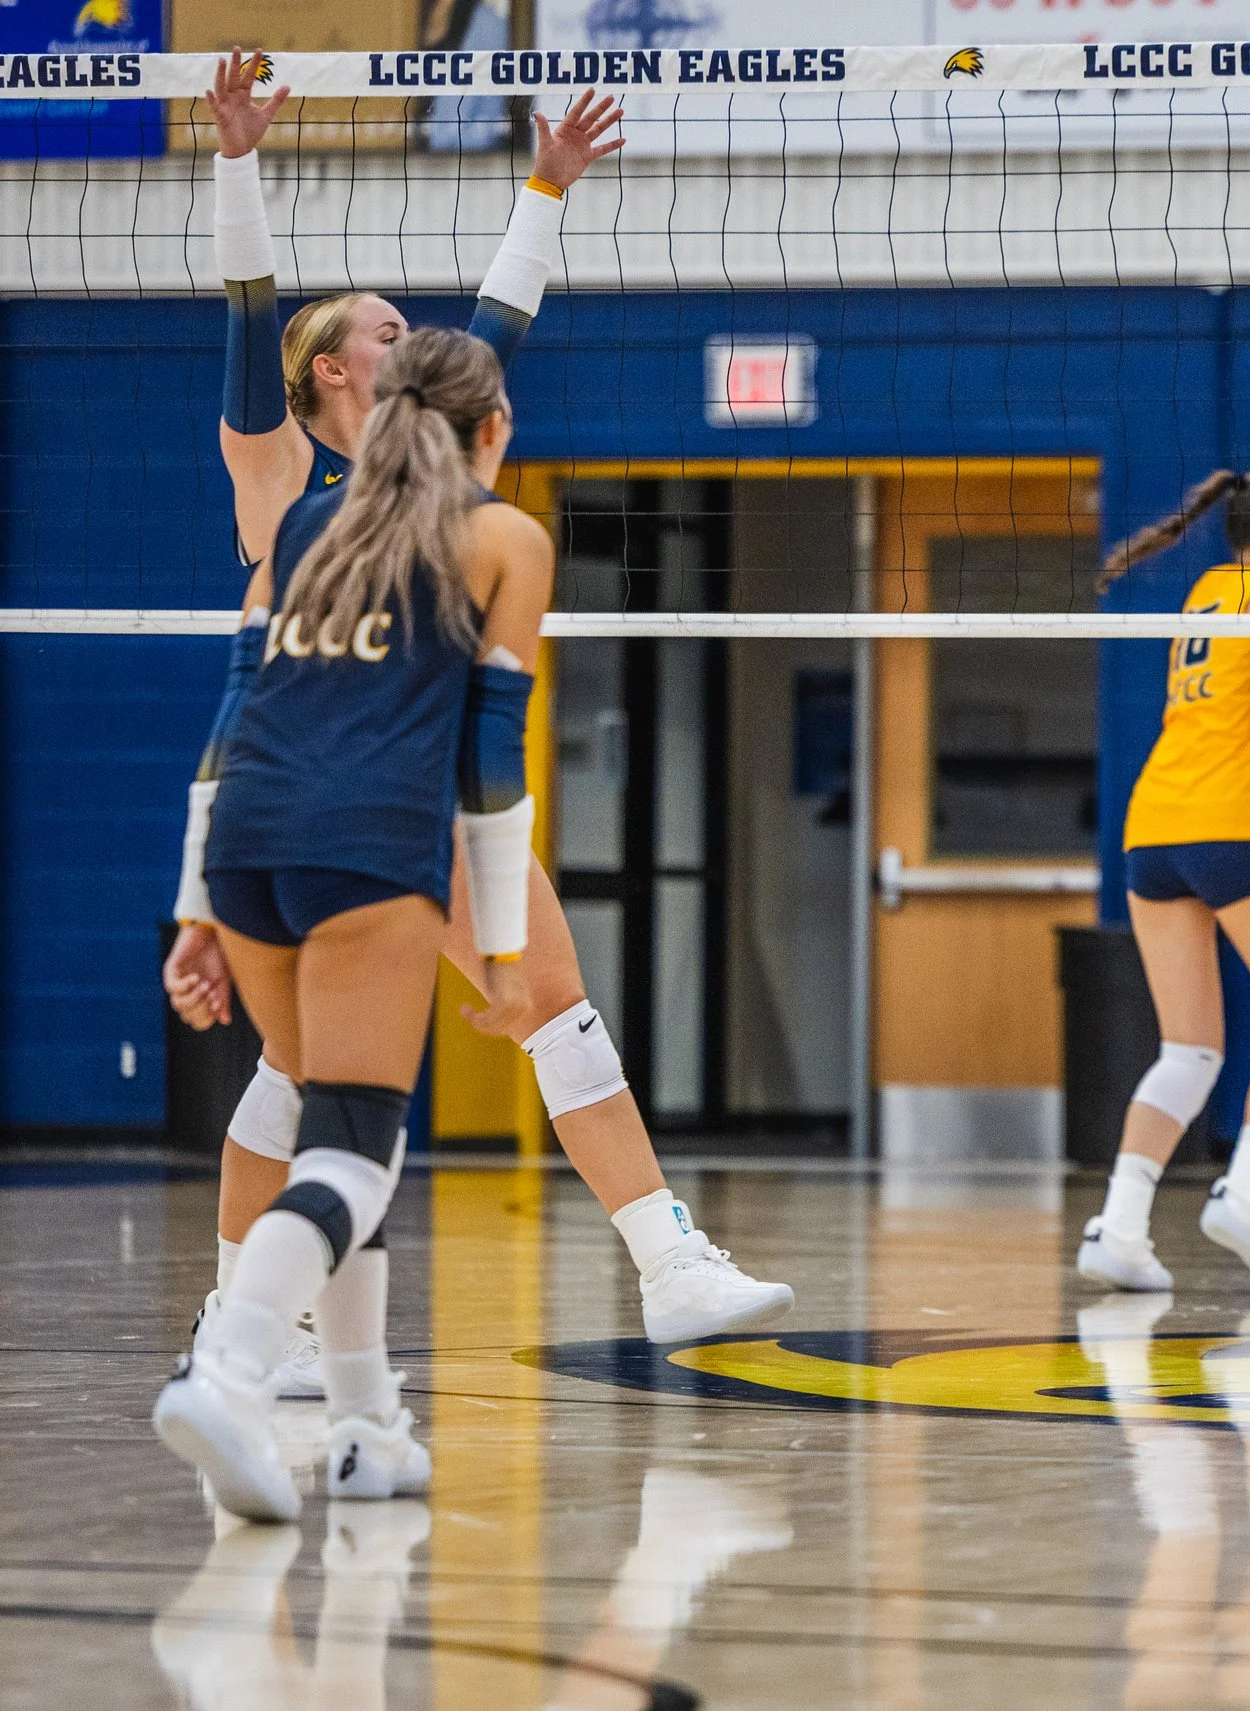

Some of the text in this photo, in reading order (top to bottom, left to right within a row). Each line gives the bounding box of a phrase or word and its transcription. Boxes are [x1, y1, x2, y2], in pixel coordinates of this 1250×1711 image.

[0, 54, 141, 88] AGLES
[369, 49, 846, 86] LCCC GOLDEN EAGLES
[1083, 44, 1193, 78] LCCC
